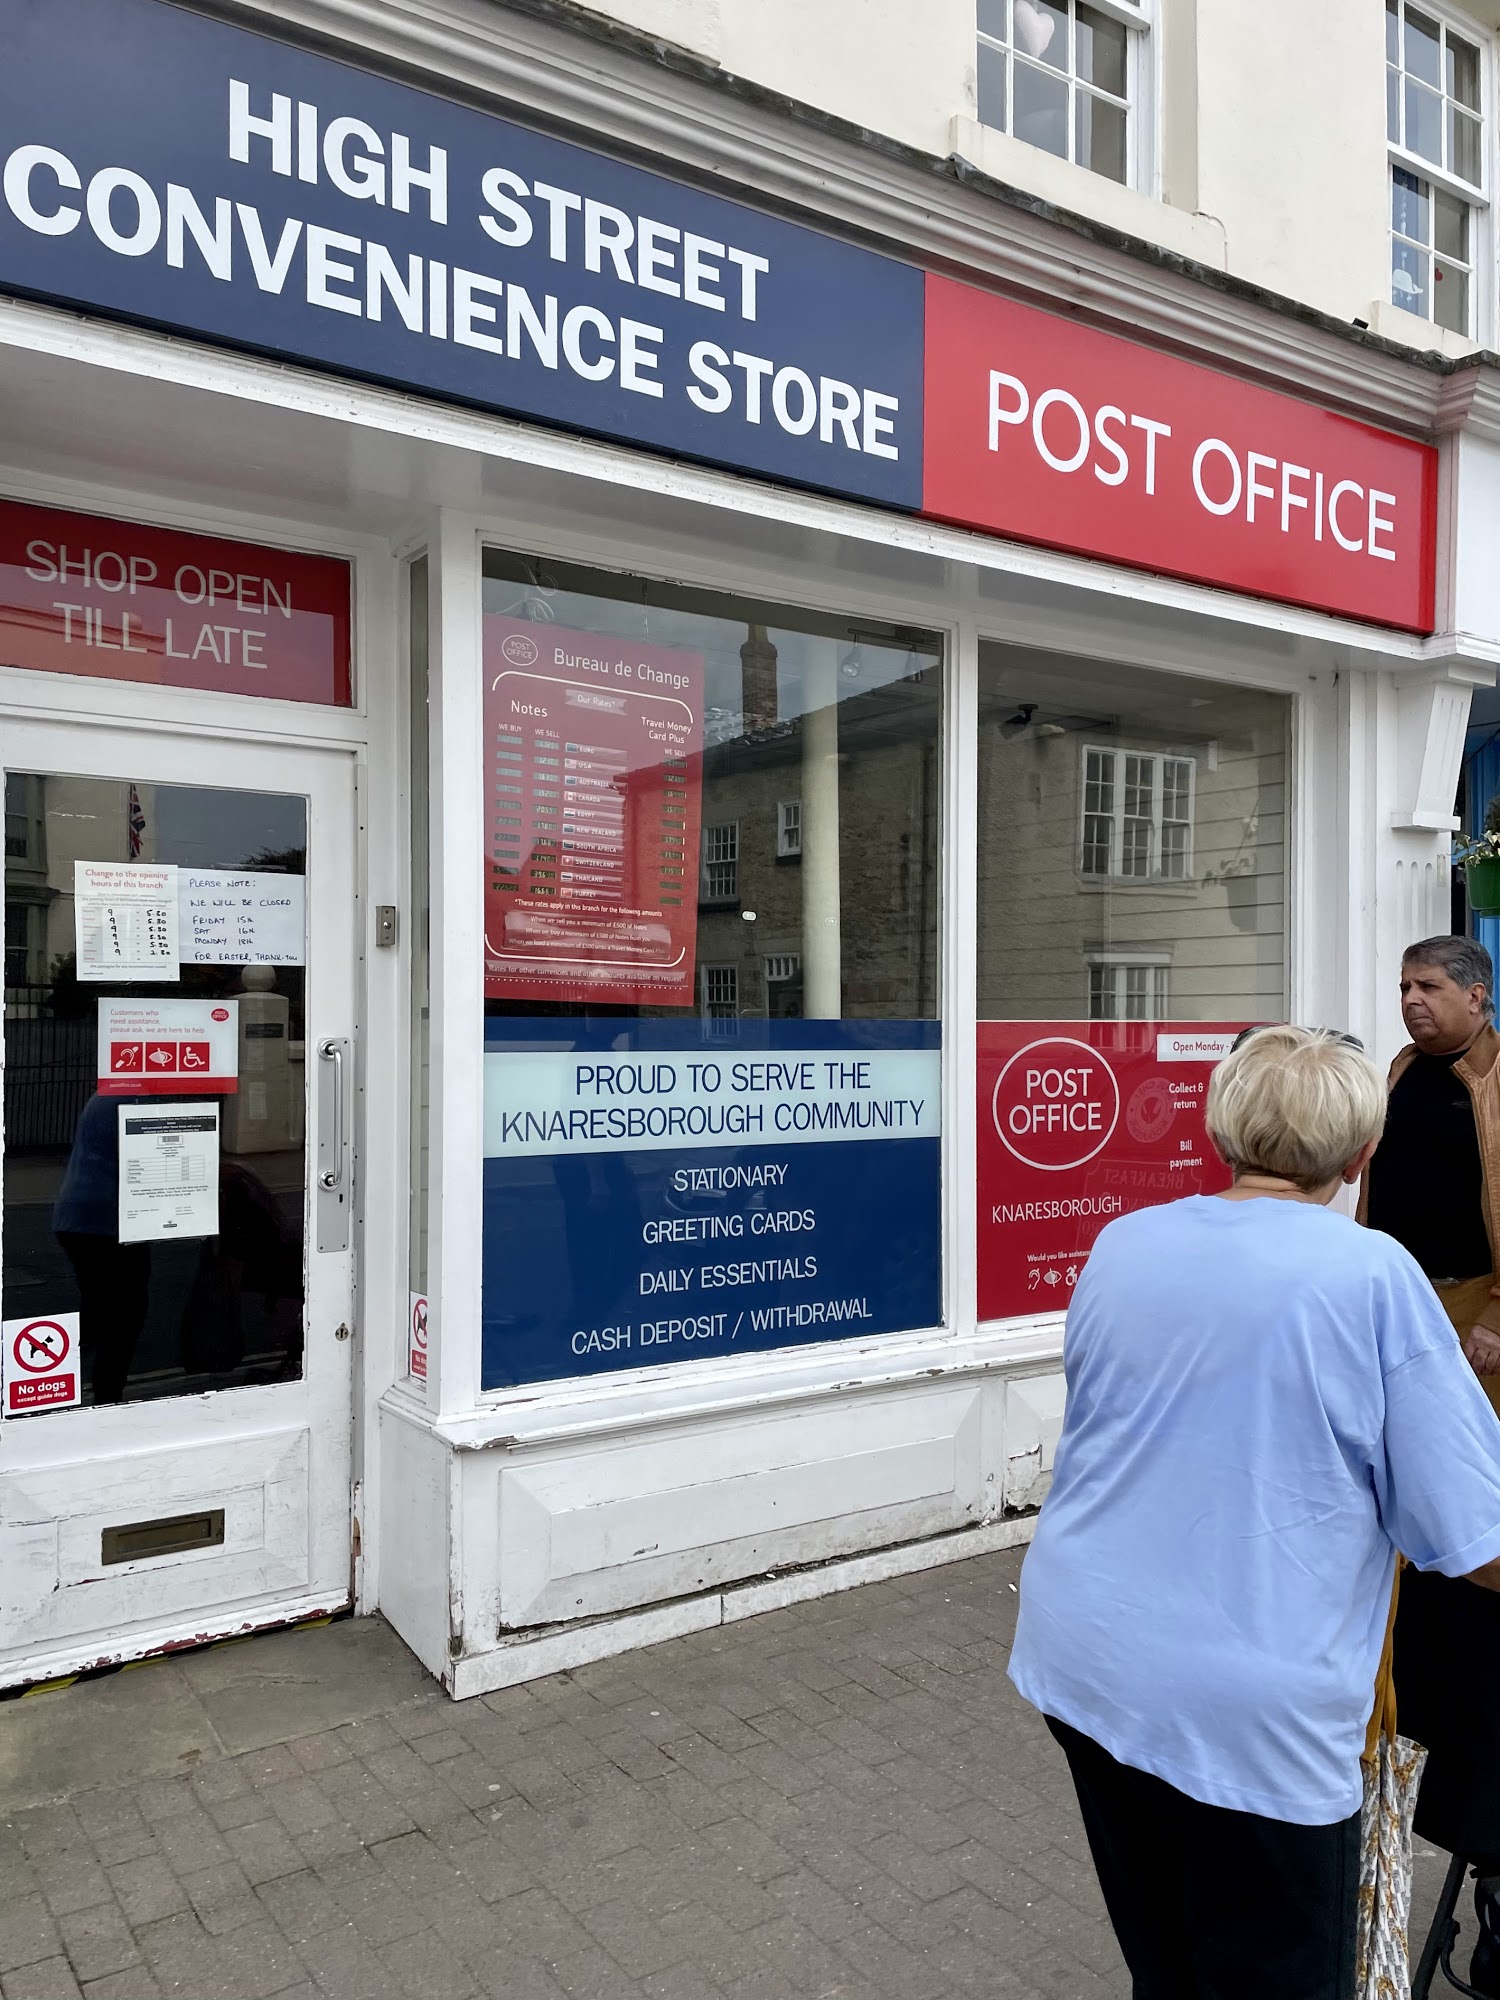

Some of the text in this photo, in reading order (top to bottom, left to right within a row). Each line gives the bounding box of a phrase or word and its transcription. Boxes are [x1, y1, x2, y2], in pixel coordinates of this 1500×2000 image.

[229, 78, 769, 321] HIGH STREET
[3, 144, 899, 460] CONVENIENCE STORE
[988, 369, 1396, 561] POST OFFICE
[24, 539, 292, 619] SHOP OPEN
[53, 601, 268, 670] TILL LATE
[511, 640, 530, 651] POST
[506, 647, 533, 659] OFFICE
[554, 648, 690, 689] Bureau de Change
[577, 694, 591, 704] Our
[511, 700, 548, 718] Notes
[498, 723, 522, 733] WE BUY
[641, 716, 692, 735] Travel Money
[535, 728, 560, 738] WE SELL
[648, 730, 685, 744] Card Plus
[664, 748, 674, 756] WE
[580, 779, 609, 788] AUSTRALIA
[578, 795, 600, 803] CANADA
[577, 811, 595, 819] EGYPT
[591, 828, 617, 837] ZEALAND
[598, 845, 617, 853] AFRICA
[575, 859, 615, 868] SWITZERLAND
[85, 868, 169, 881] Change to the opening
[575, 875, 603, 883] THAILAND
[91, 879, 163, 889] hours of this branch
[227, 880, 256, 888] NOTE:
[190, 899, 206, 907] WE
[213, 899, 236, 907] WILL
[534, 900, 548, 908] rates
[549, 902, 565, 910] apply
[601, 905, 609, 913] for
[609, 906, 618, 914] the
[618, 907, 641, 917] following
[107, 908, 113, 917] 9
[109, 917, 116, 925] 9
[192, 915, 225, 925] FRIDAY
[530, 915, 546, 923] When
[110, 925, 117, 933] 9
[194, 927, 210, 935] SAT
[194, 937, 227, 945] MONDAY
[114, 948, 121, 956] 9
[194, 952, 211, 961] FOR
[489, 964, 506, 972] Rates
[508, 965, 517, 973] for
[519, 966, 536, 974] other
[537, 968, 569, 976] currencies
[600, 971, 626, 979] amounts
[110, 1008, 144, 1016] Customers
[1173, 1041, 1194, 1054] Open
[1195, 1041, 1225, 1054] Monday
[575, 1061, 871, 1096] PROUD TO SERVE THE
[1026, 1068, 1094, 1099] POST
[1168, 1082, 1204, 1094] Collect &
[1173, 1100, 1197, 1109] return
[502, 1100, 925, 1143] KNARESBOROUGH COMMUNITY
[1008, 1102, 1102, 1135] OFFICE
[1180, 1140, 1193, 1151] Bill
[1169, 1157, 1203, 1171] payment
[673, 1163, 789, 1192] STATIONARY
[992, 1195, 1122, 1224] KNARESBOROUGH
[642, 1209, 816, 1244] GREETING CARDS
[1027, 1251, 1067, 1262] Would you like
[639, 1256, 818, 1296] DAILY ESSENTIALS
[570, 1298, 873, 1356] CASH DEPOSIT / WITHDRAWAL
[18, 1381, 67, 1395] No dogs
[37, 1393, 53, 1401] guide
